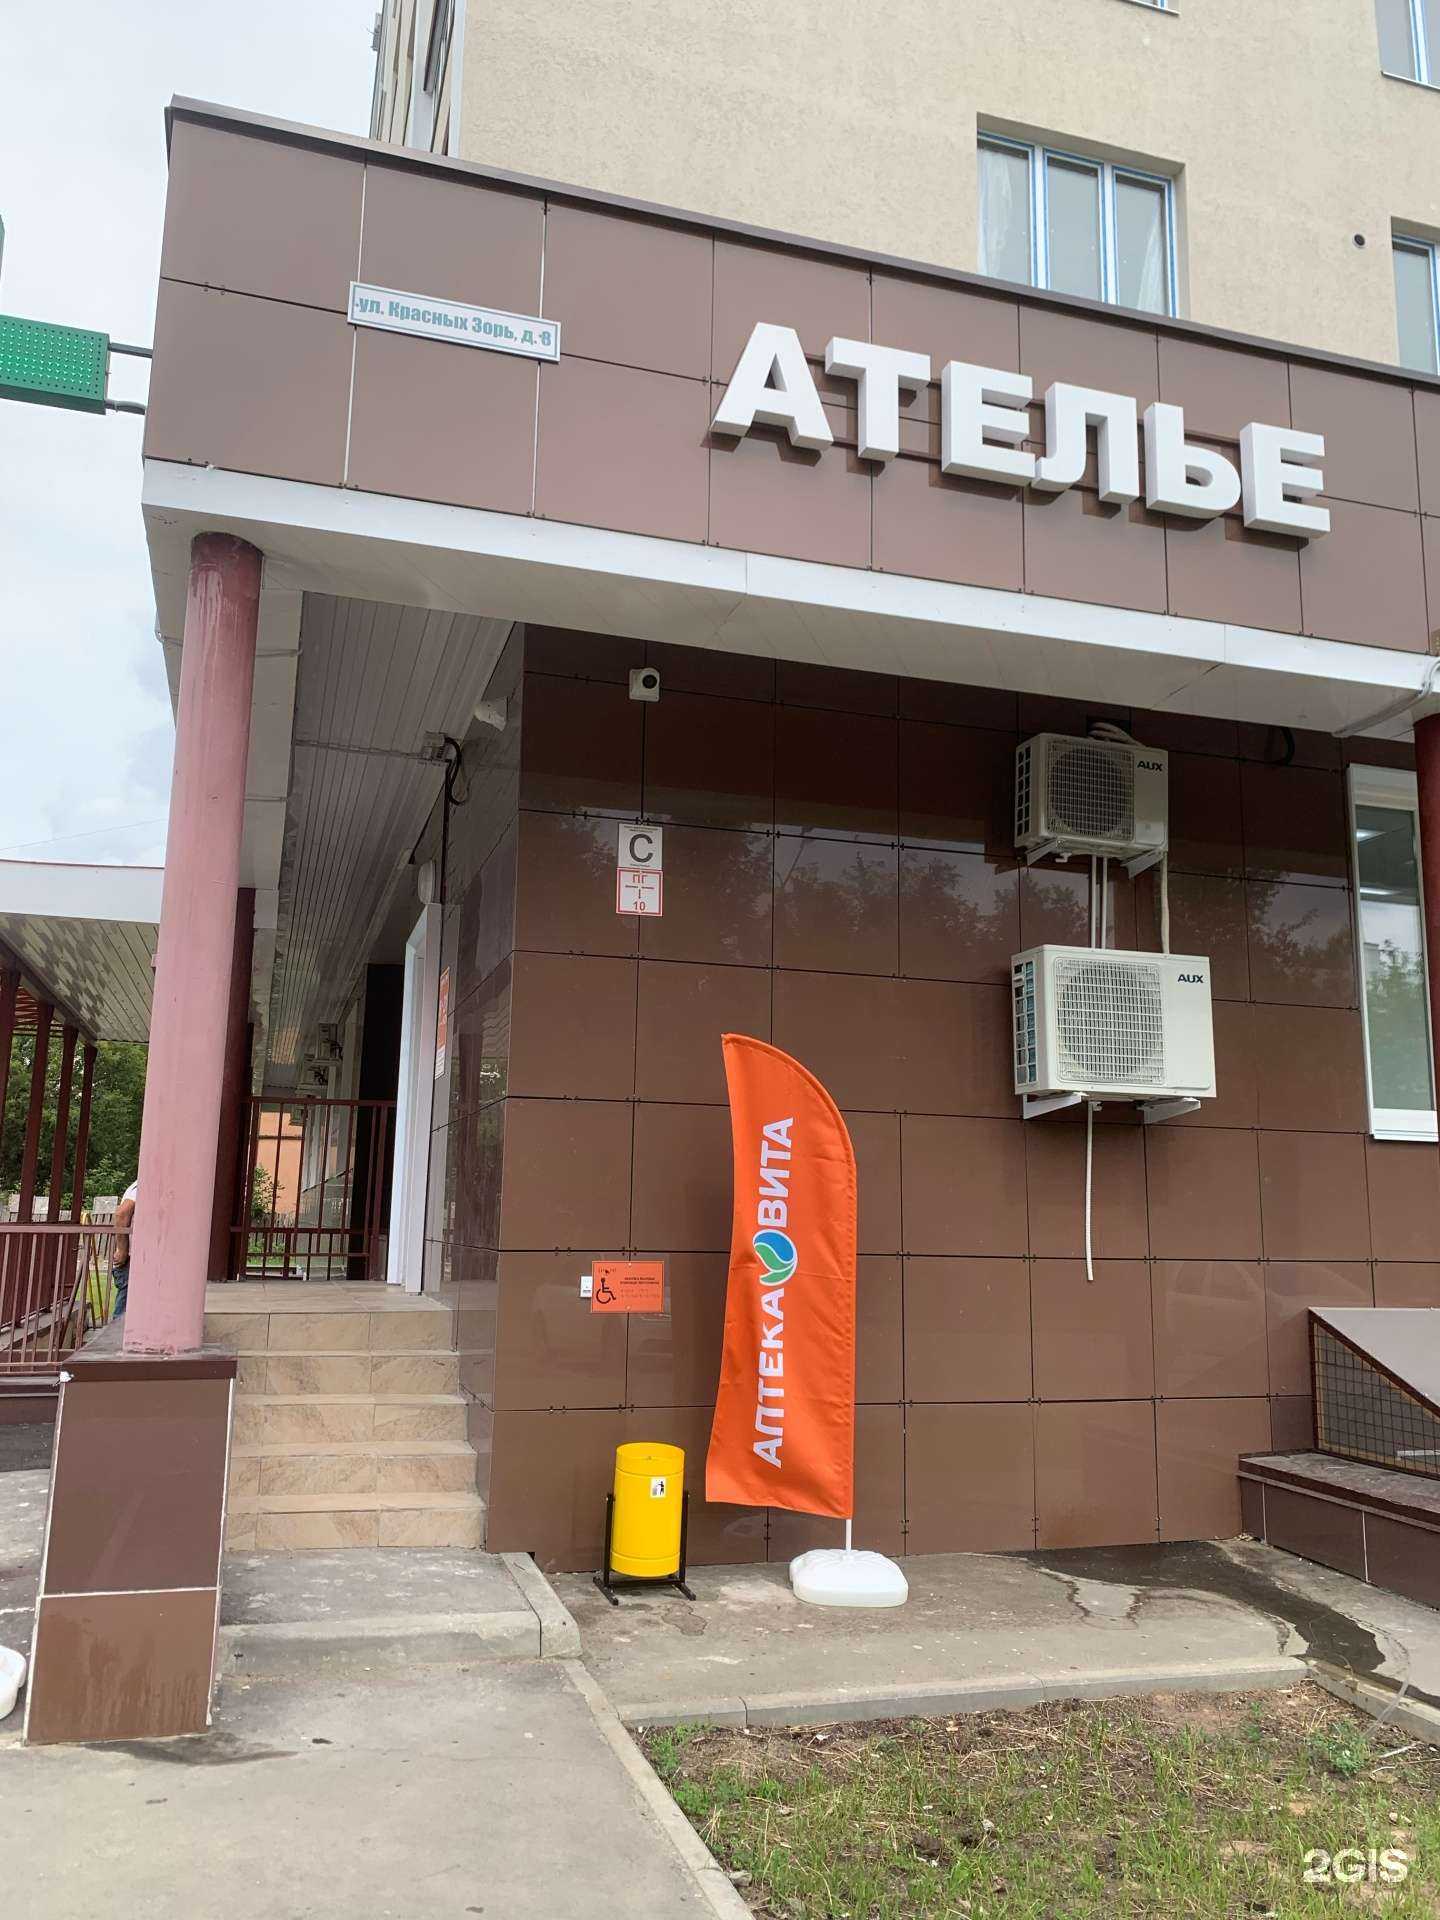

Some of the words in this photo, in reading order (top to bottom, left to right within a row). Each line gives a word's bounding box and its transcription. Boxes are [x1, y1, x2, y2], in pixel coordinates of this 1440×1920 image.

[358, 298, 385, 316] ул.
[388, 301, 469, 331] Красных
[472, 316, 518, 342] Зорь,
[709, 321, 1331, 539] АТЕЛЬЕ
[1136, 760, 1163, 772] AUX
[632, 873, 648, 884] ПГ
[632, 901, 646, 911] 10
[1177, 973, 1204, 984] AUX
[756, 1116, 795, 1229] ВИТА
[752, 1287, 785, 1470] АПТЕКА
